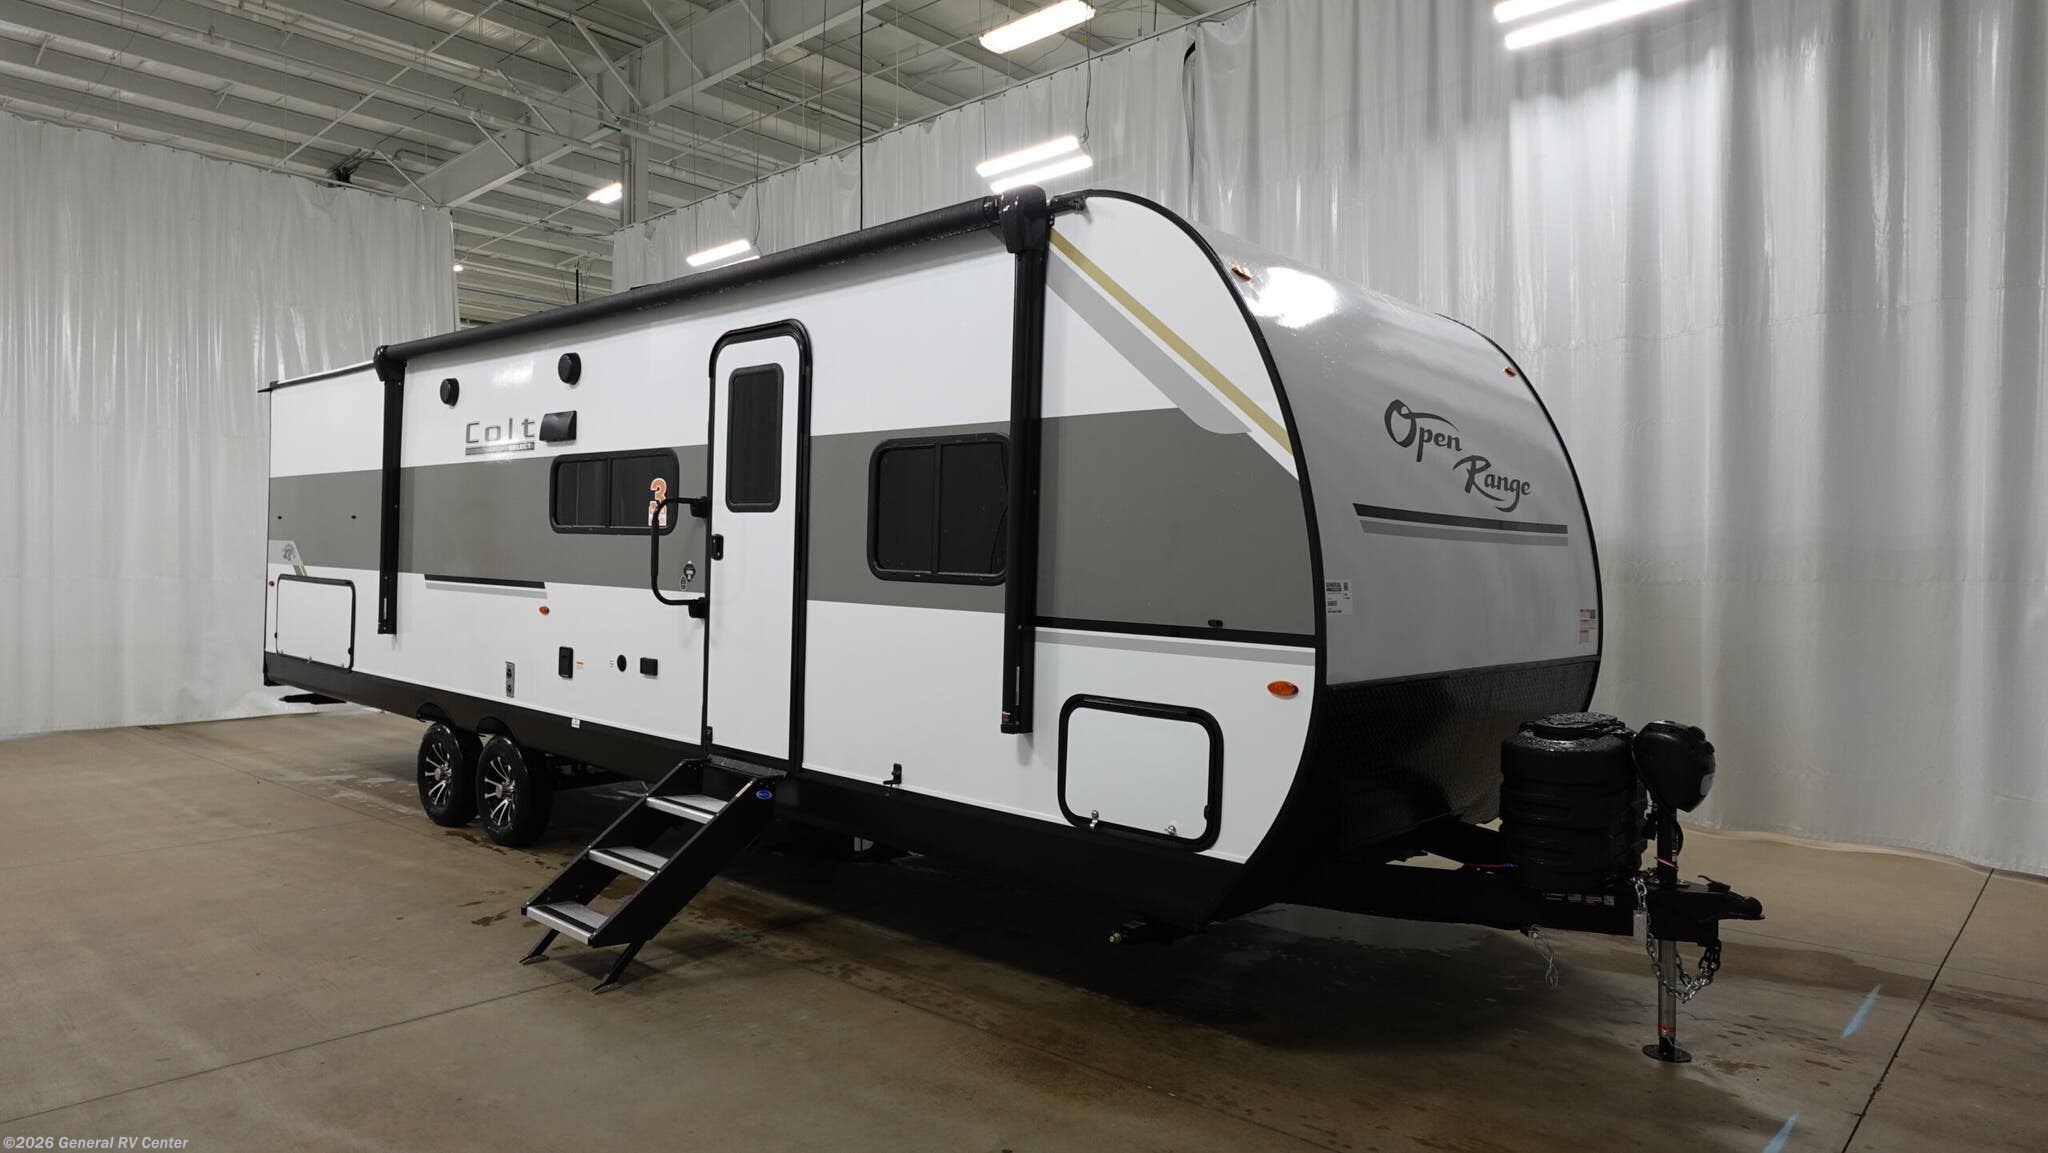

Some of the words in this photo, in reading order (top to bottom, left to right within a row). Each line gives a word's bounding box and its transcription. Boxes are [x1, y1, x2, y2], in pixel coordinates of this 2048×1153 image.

[466, 417, 535, 443] Colt
[1384, 399, 1462, 462] Open
[1453, 455, 1531, 513] Range
